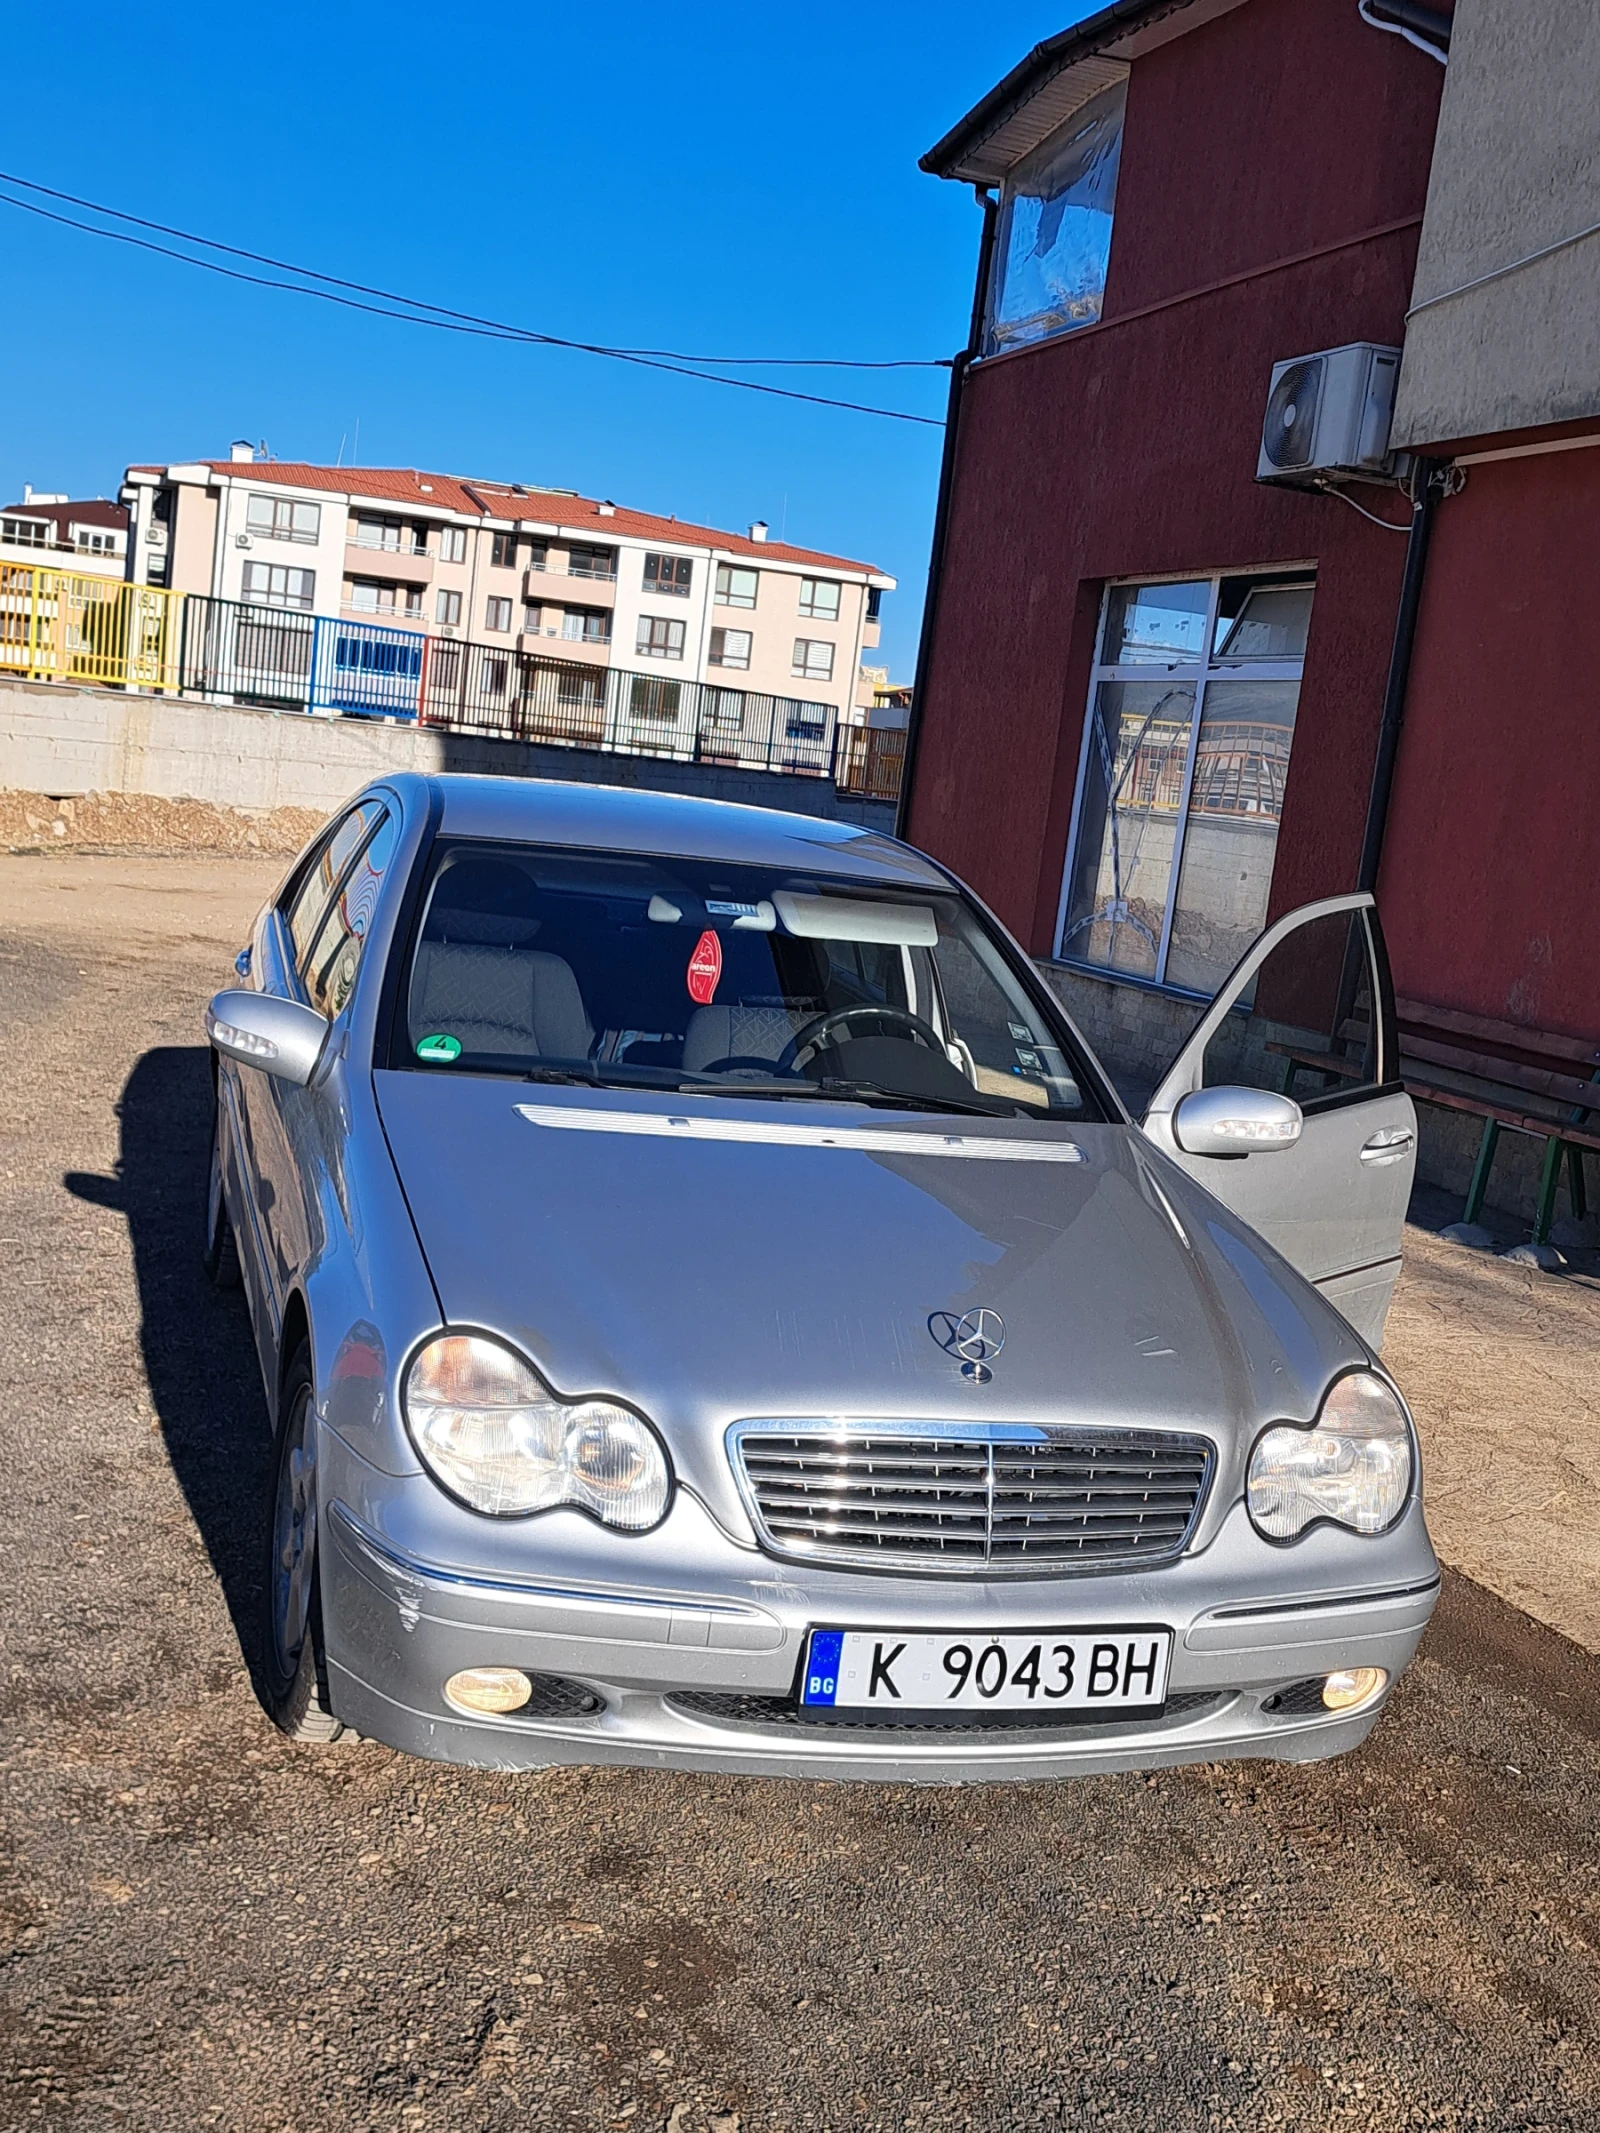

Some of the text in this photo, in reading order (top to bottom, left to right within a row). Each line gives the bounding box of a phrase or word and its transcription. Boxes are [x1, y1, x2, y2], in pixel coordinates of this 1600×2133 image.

[691, 963, 716, 972] areon
[433, 1036, 448, 1050] 4
[868, 1642, 1159, 1699] K 9043 BH
[809, 1677, 835, 1695] BG
